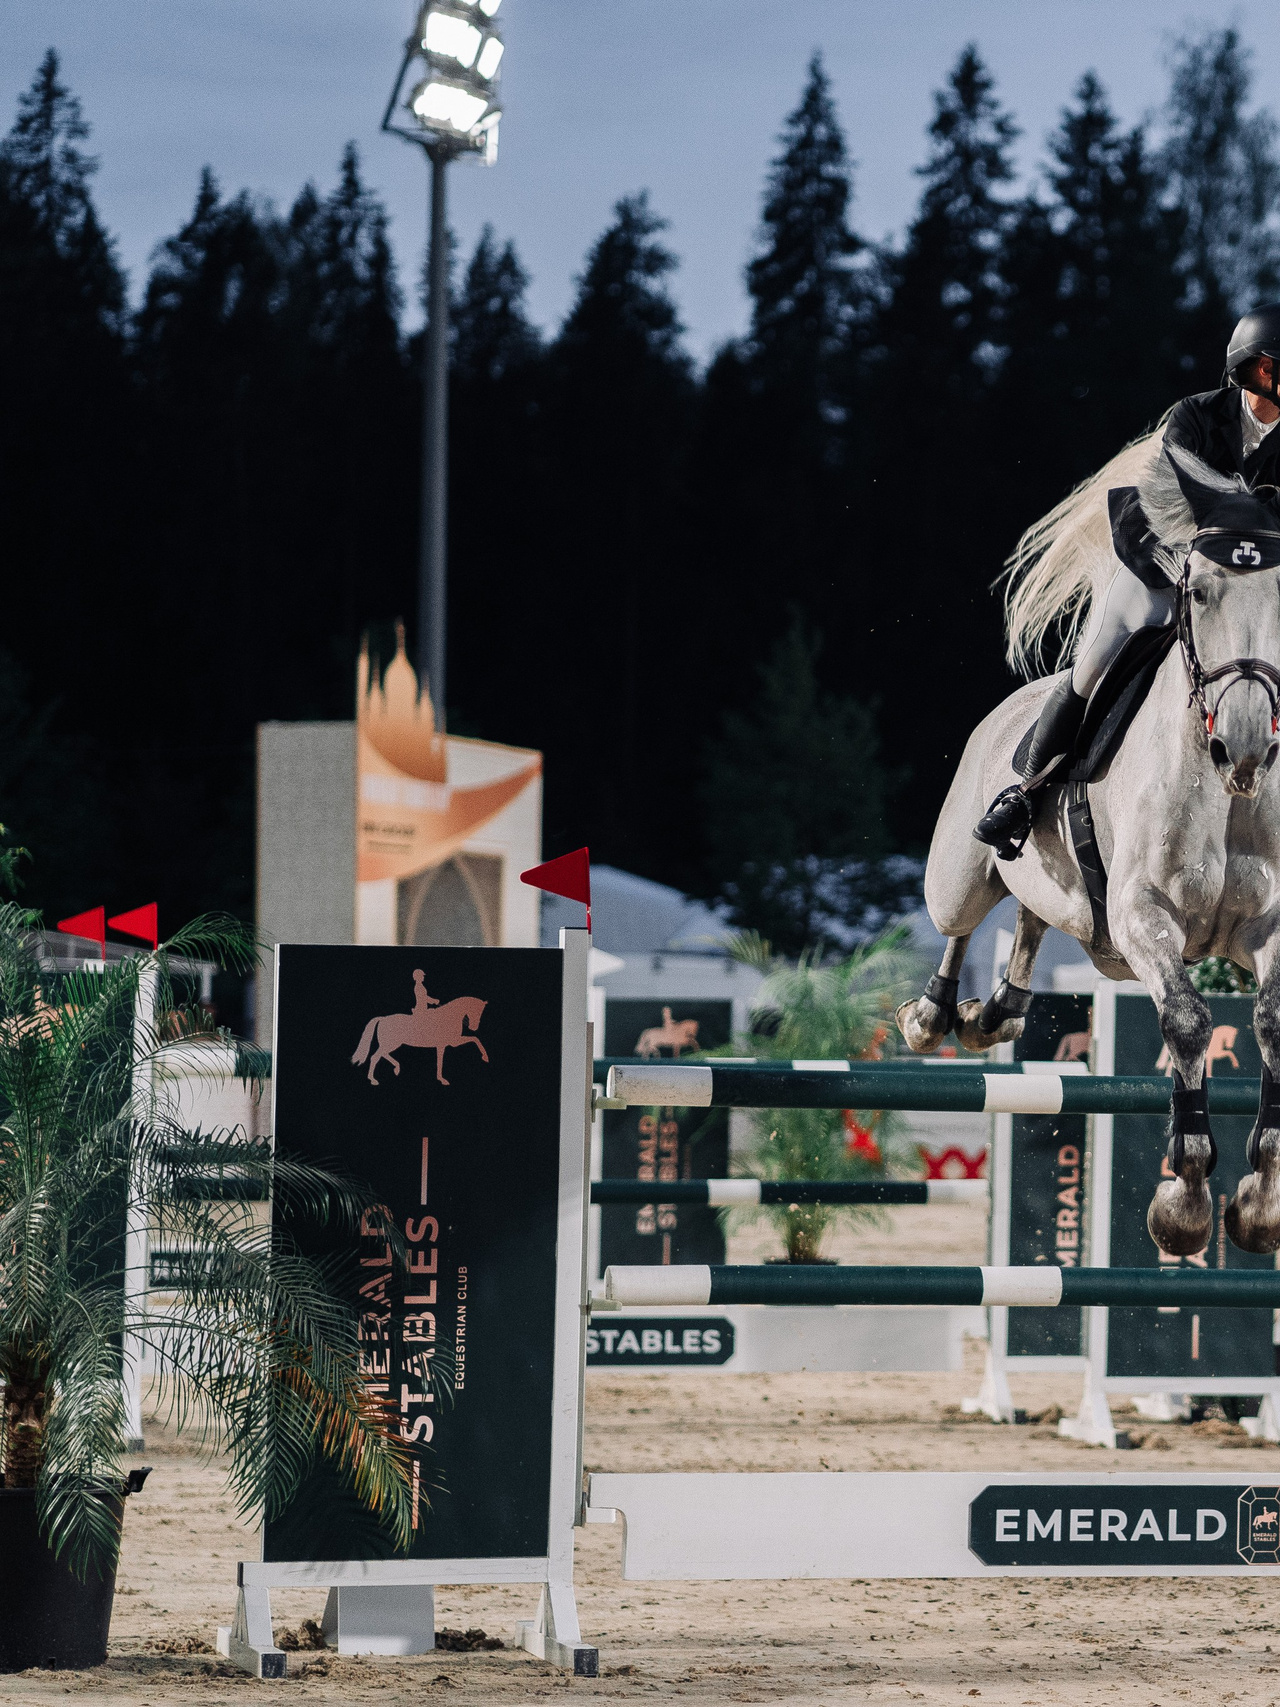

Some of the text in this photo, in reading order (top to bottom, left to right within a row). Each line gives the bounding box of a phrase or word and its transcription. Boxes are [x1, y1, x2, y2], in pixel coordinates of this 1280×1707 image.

[636, 1114, 658, 1235] EMRALD
[1056, 1144, 1080, 1267] MERALD
[400, 1215, 439, 1443] STABLES
[454, 1265, 468, 1390] EQUESTRIAN CLUB
[586, 1329, 722, 1354] STABLES
[995, 1508, 1228, 1542] EMERALD
